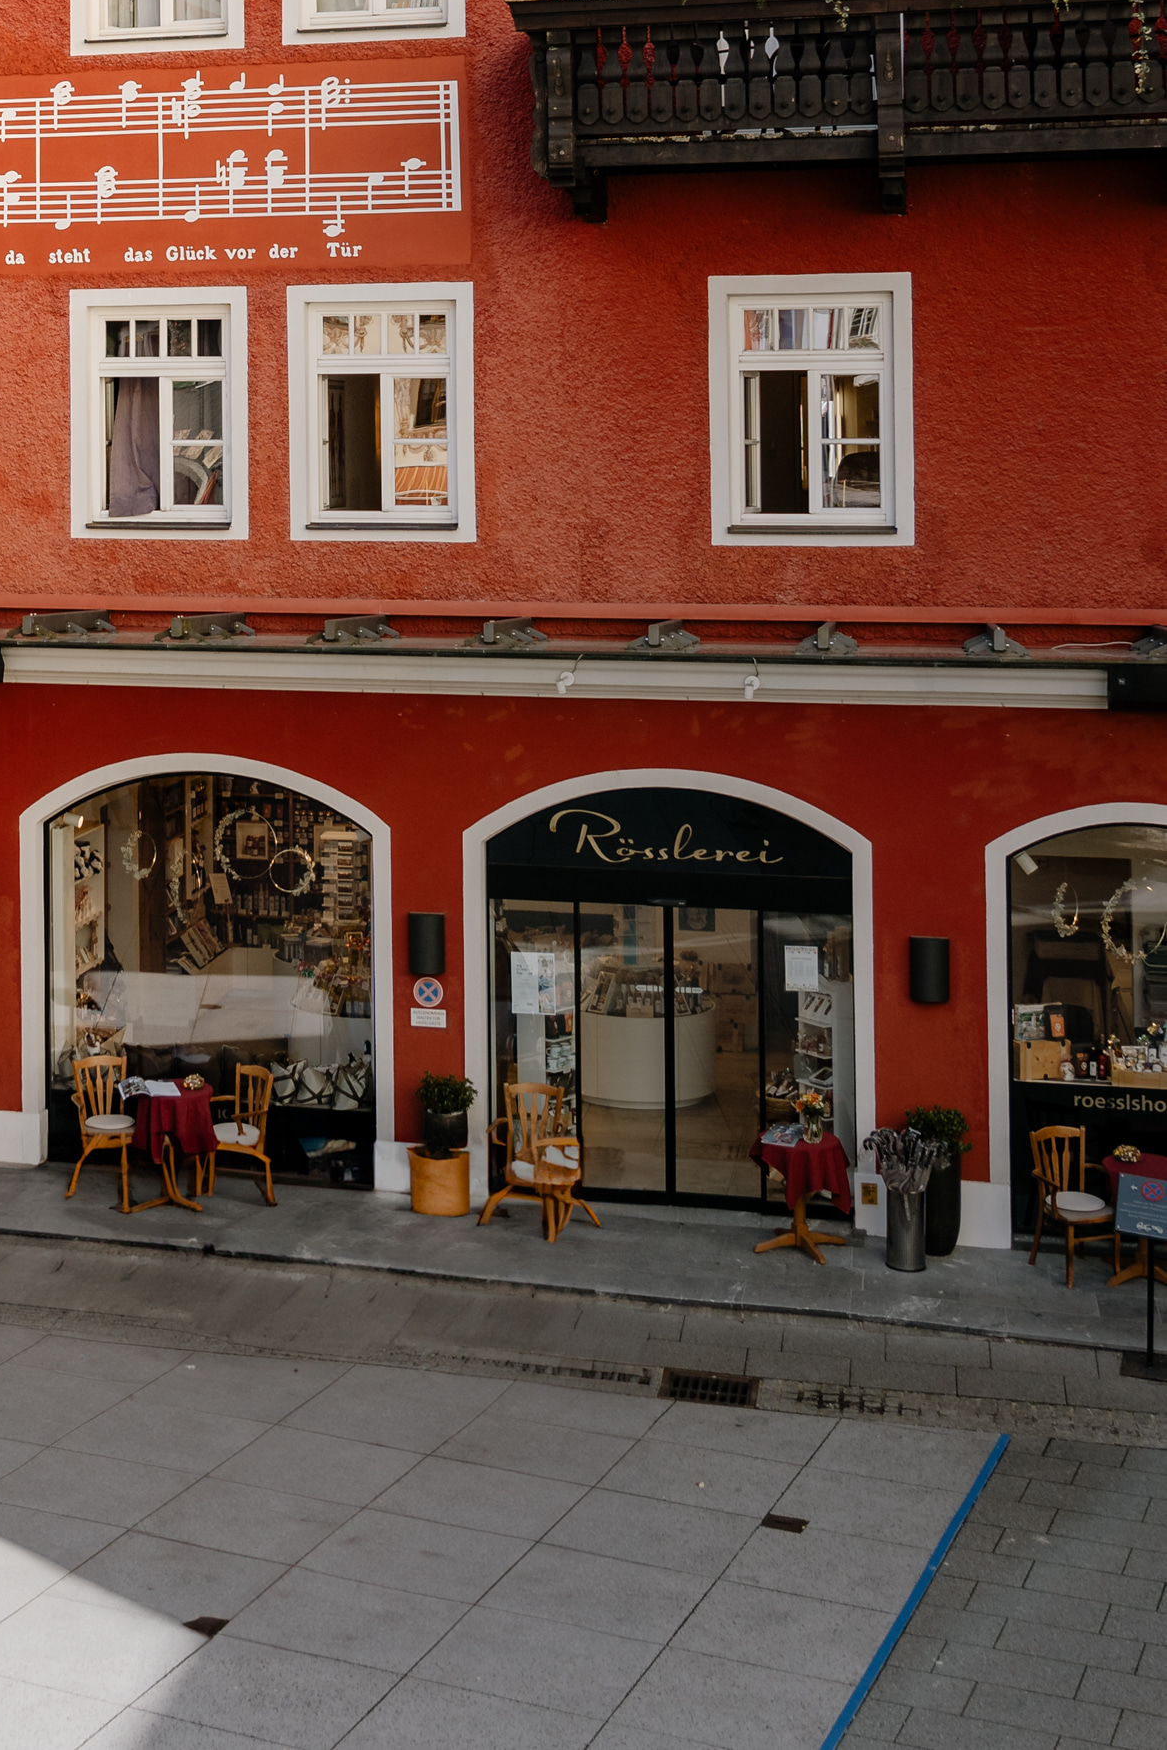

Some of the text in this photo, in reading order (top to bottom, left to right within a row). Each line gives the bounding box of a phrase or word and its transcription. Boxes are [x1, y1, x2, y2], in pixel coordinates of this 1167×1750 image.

[4, 249, 26, 265] da
[48, 248, 91, 264] steht
[123, 246, 153, 263] das
[165, 245, 218, 262] Glück
[223, 247, 257, 260] vor
[268, 243, 299, 259] der
[326, 241, 363, 258] Tür
[549, 809, 783, 864] Rösslerei
